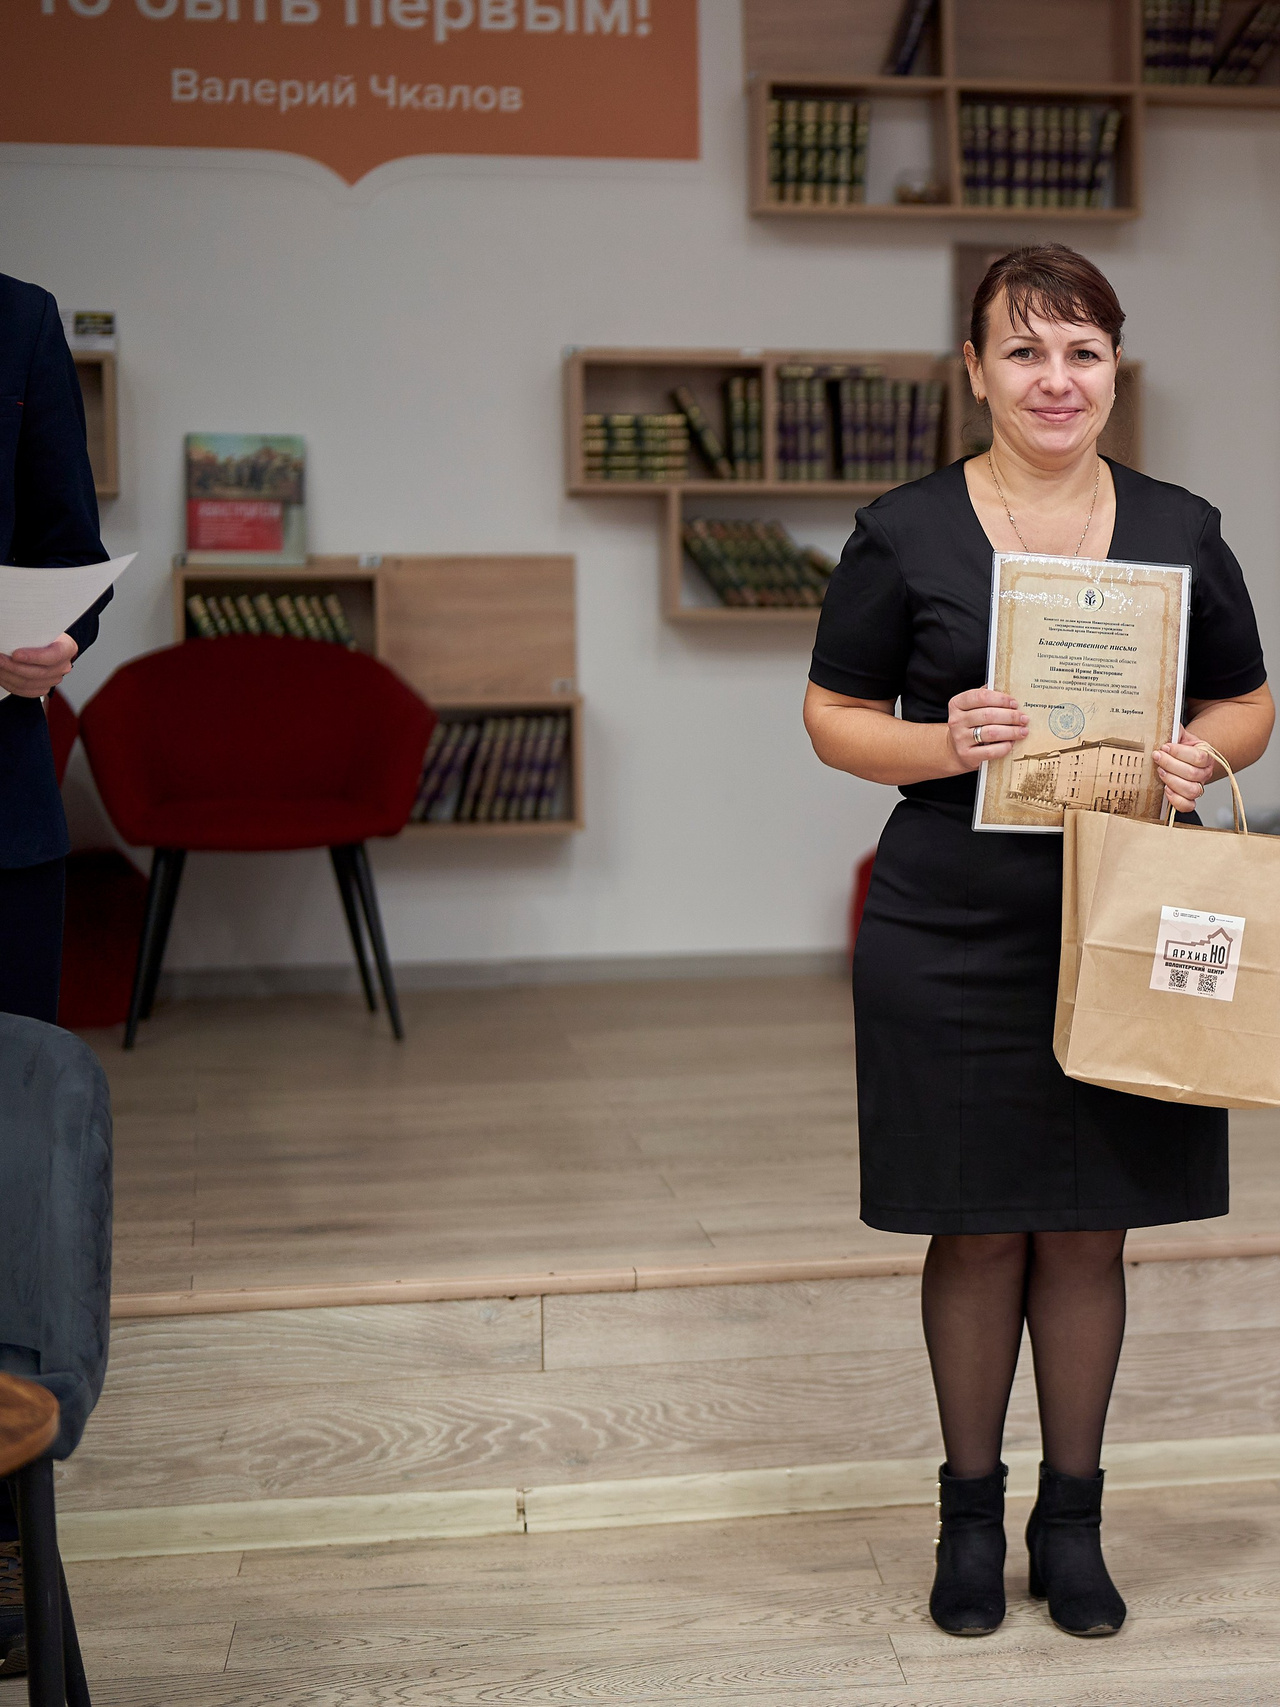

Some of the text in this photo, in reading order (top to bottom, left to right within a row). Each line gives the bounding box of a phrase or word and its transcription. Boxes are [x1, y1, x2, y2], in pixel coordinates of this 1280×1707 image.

[170, 66, 524, 114] Валерий Чкалов
[1038, 638, 1138, 652] Благодарственное письмо
[1165, 961, 1205, 972] ВОЛОНТЕРСКИЙ
